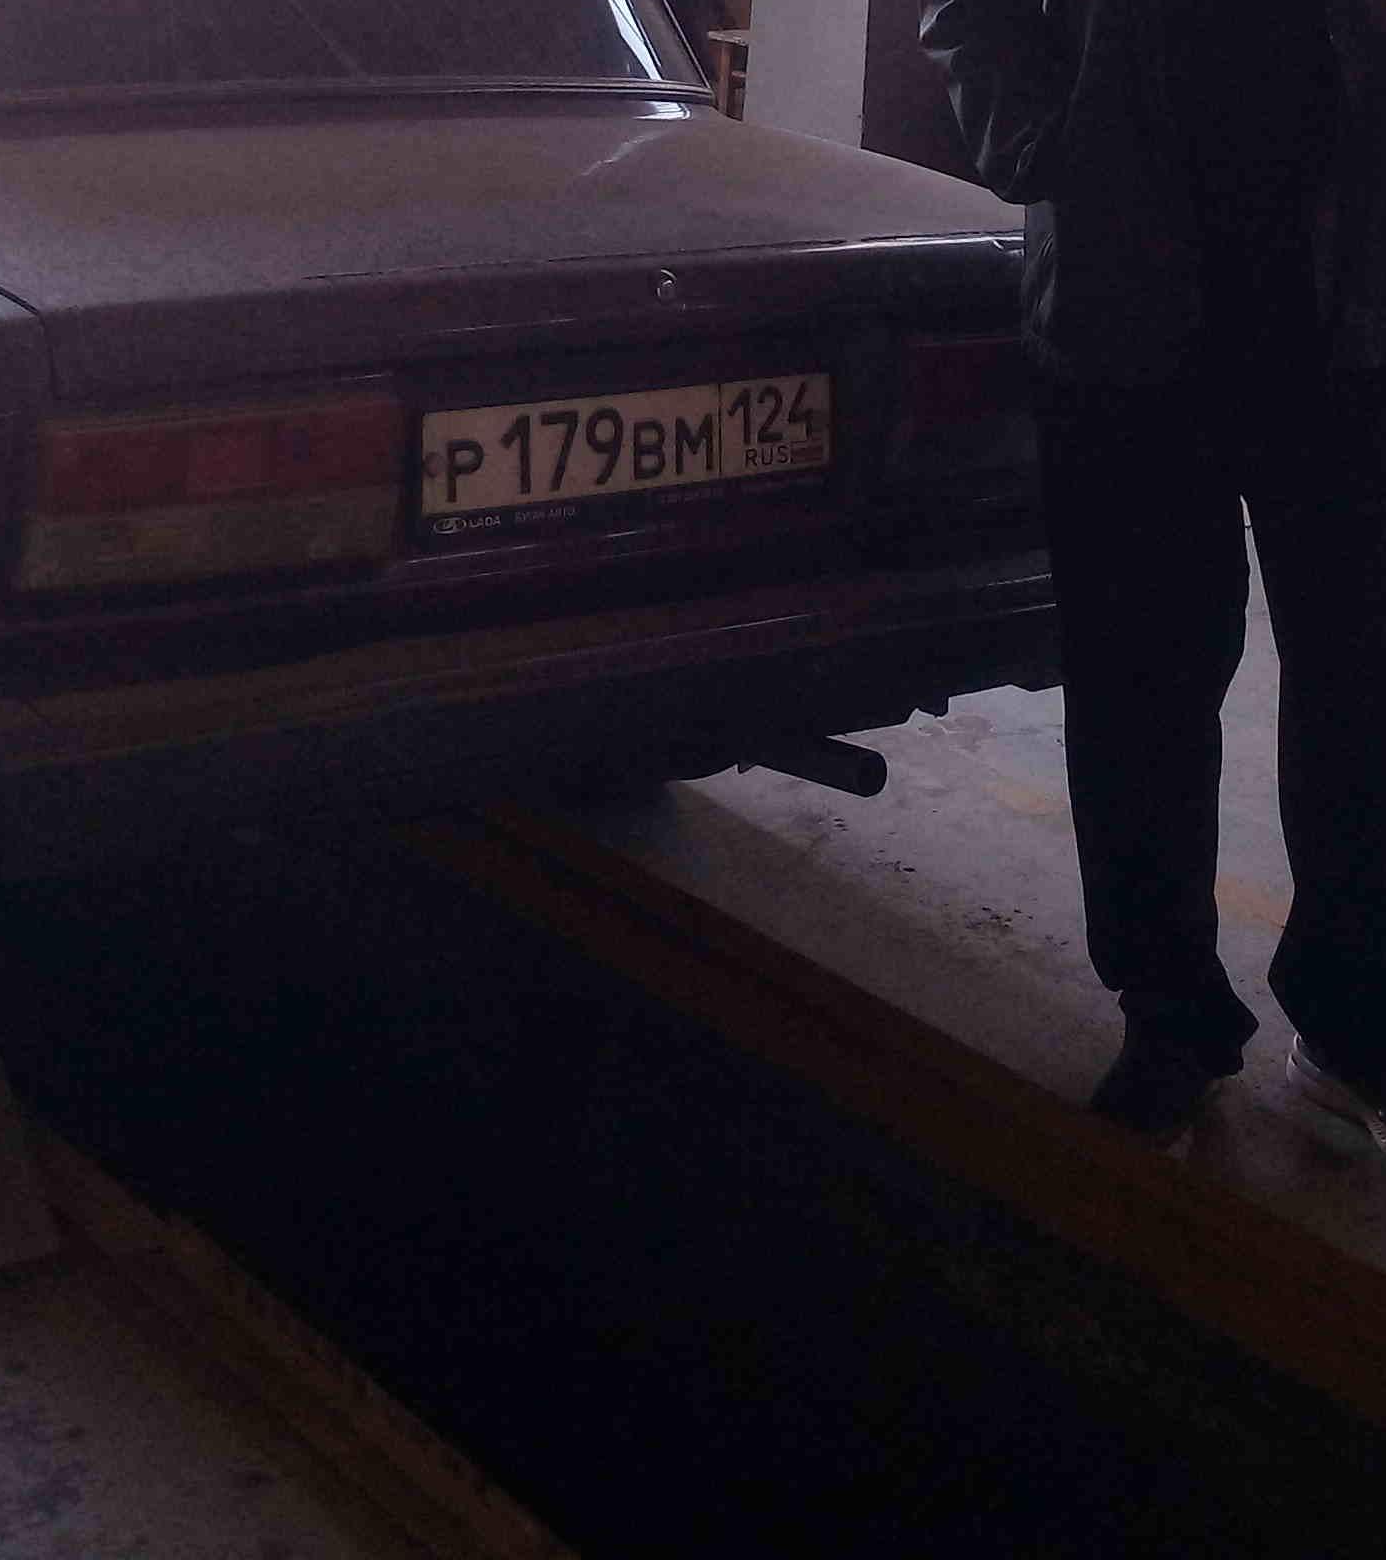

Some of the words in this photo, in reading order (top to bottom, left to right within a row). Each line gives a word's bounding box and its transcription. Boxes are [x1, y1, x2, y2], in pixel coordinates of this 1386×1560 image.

[726, 381, 815, 444] 124
[743, 444, 790, 468] RUS
[468, 514, 502, 529] LADA
